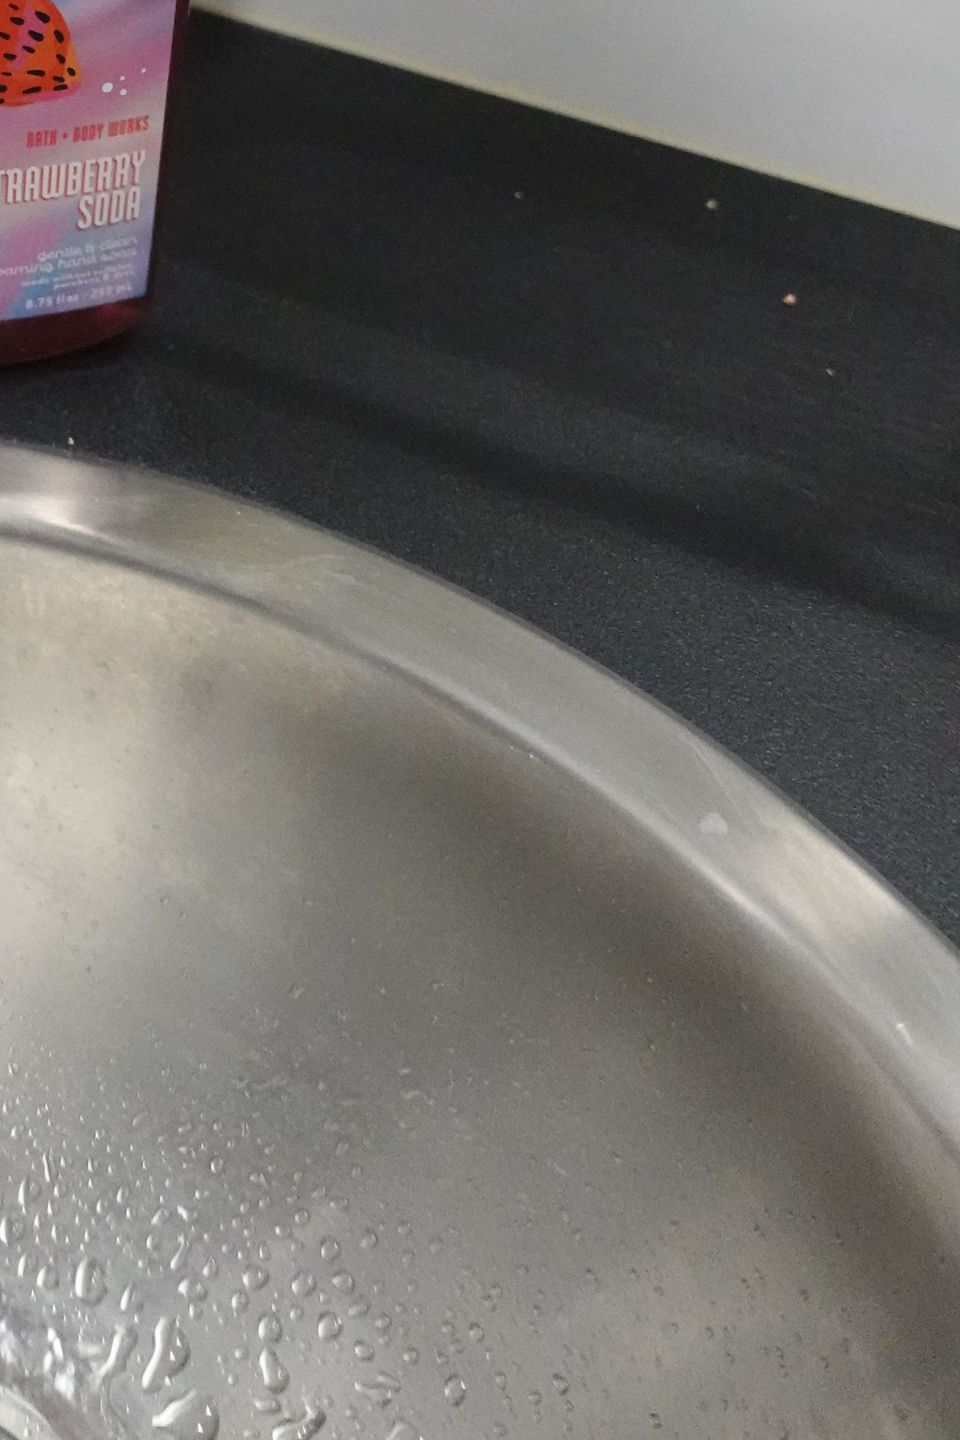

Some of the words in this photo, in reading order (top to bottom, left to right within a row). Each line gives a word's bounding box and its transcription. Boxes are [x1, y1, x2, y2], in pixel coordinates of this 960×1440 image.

[26, 129, 57, 148] BATH
[73, 123, 105, 143] BODY
[108, 115, 150, 137] WORKS
[77, 185, 141, 231] SODA
